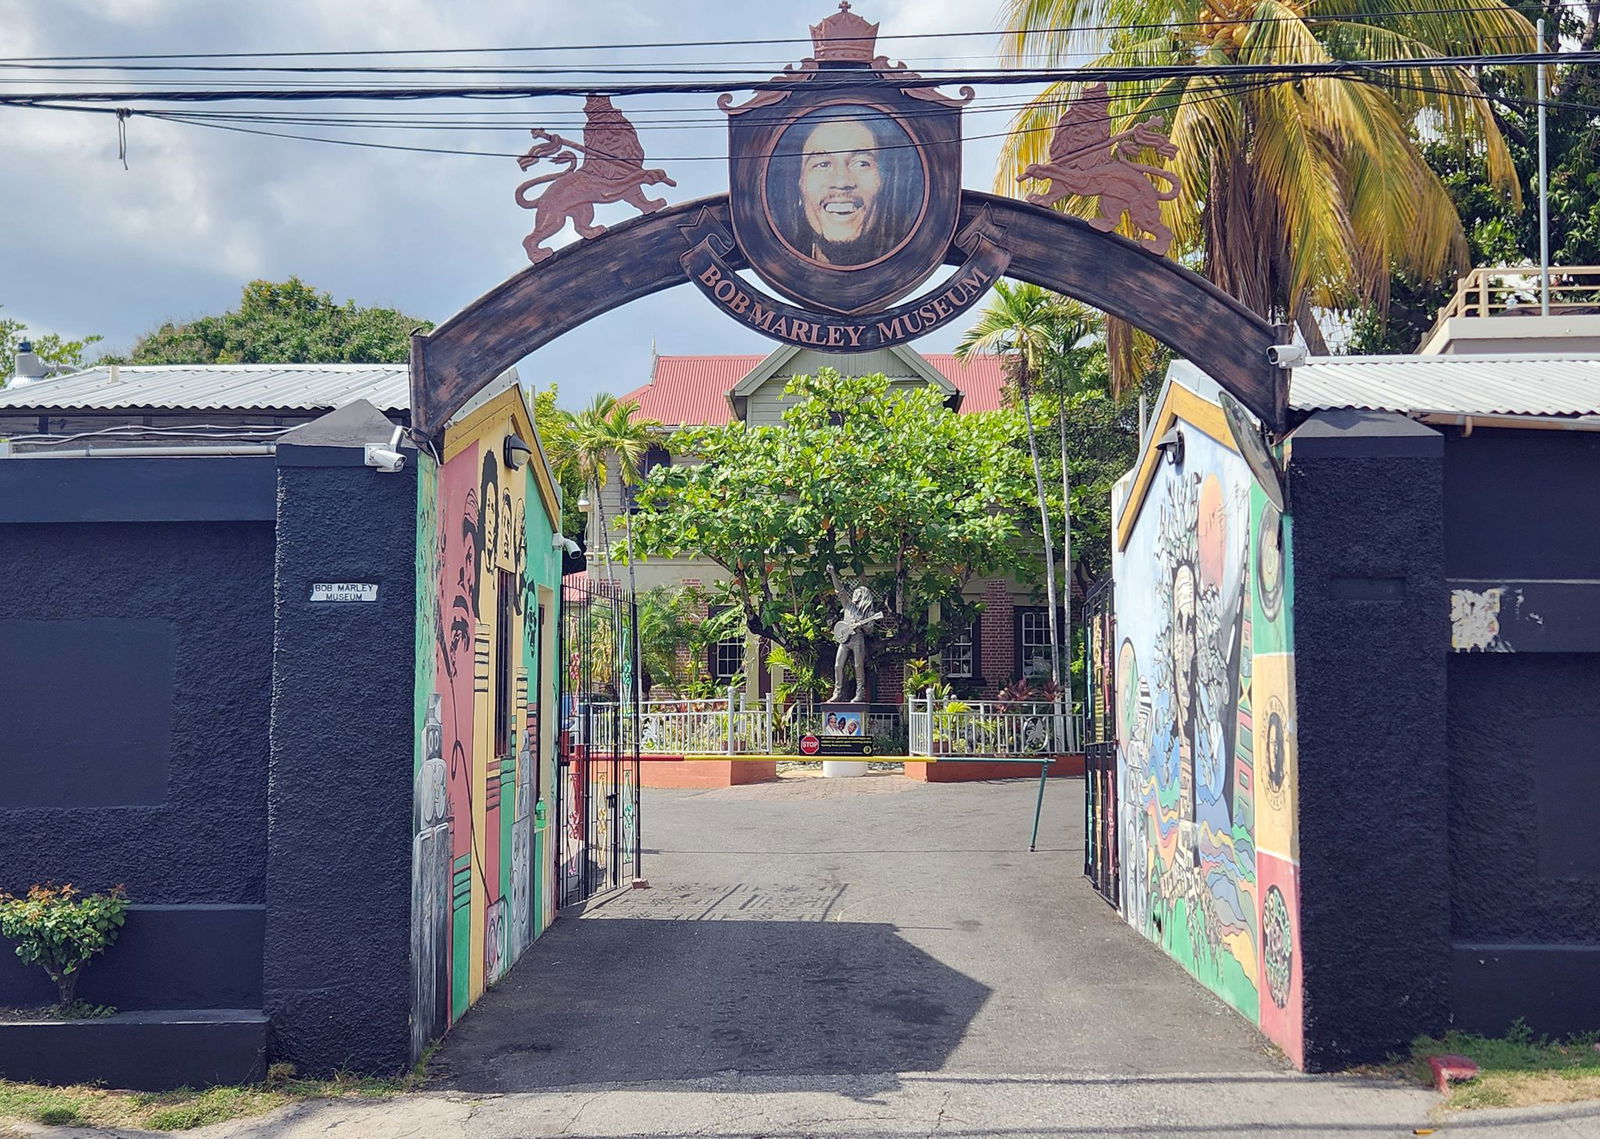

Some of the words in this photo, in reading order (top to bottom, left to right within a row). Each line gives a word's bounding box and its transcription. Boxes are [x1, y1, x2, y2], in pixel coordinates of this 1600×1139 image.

[698, 263, 750, 314] BOB
[749, 304, 866, 346] MARLEY
[876, 268, 991, 343] MUSEUM
[315, 584, 332, 592] BOB
[337, 584, 373, 592] MARLEY
[326, 593, 362, 601] MUSEUM
